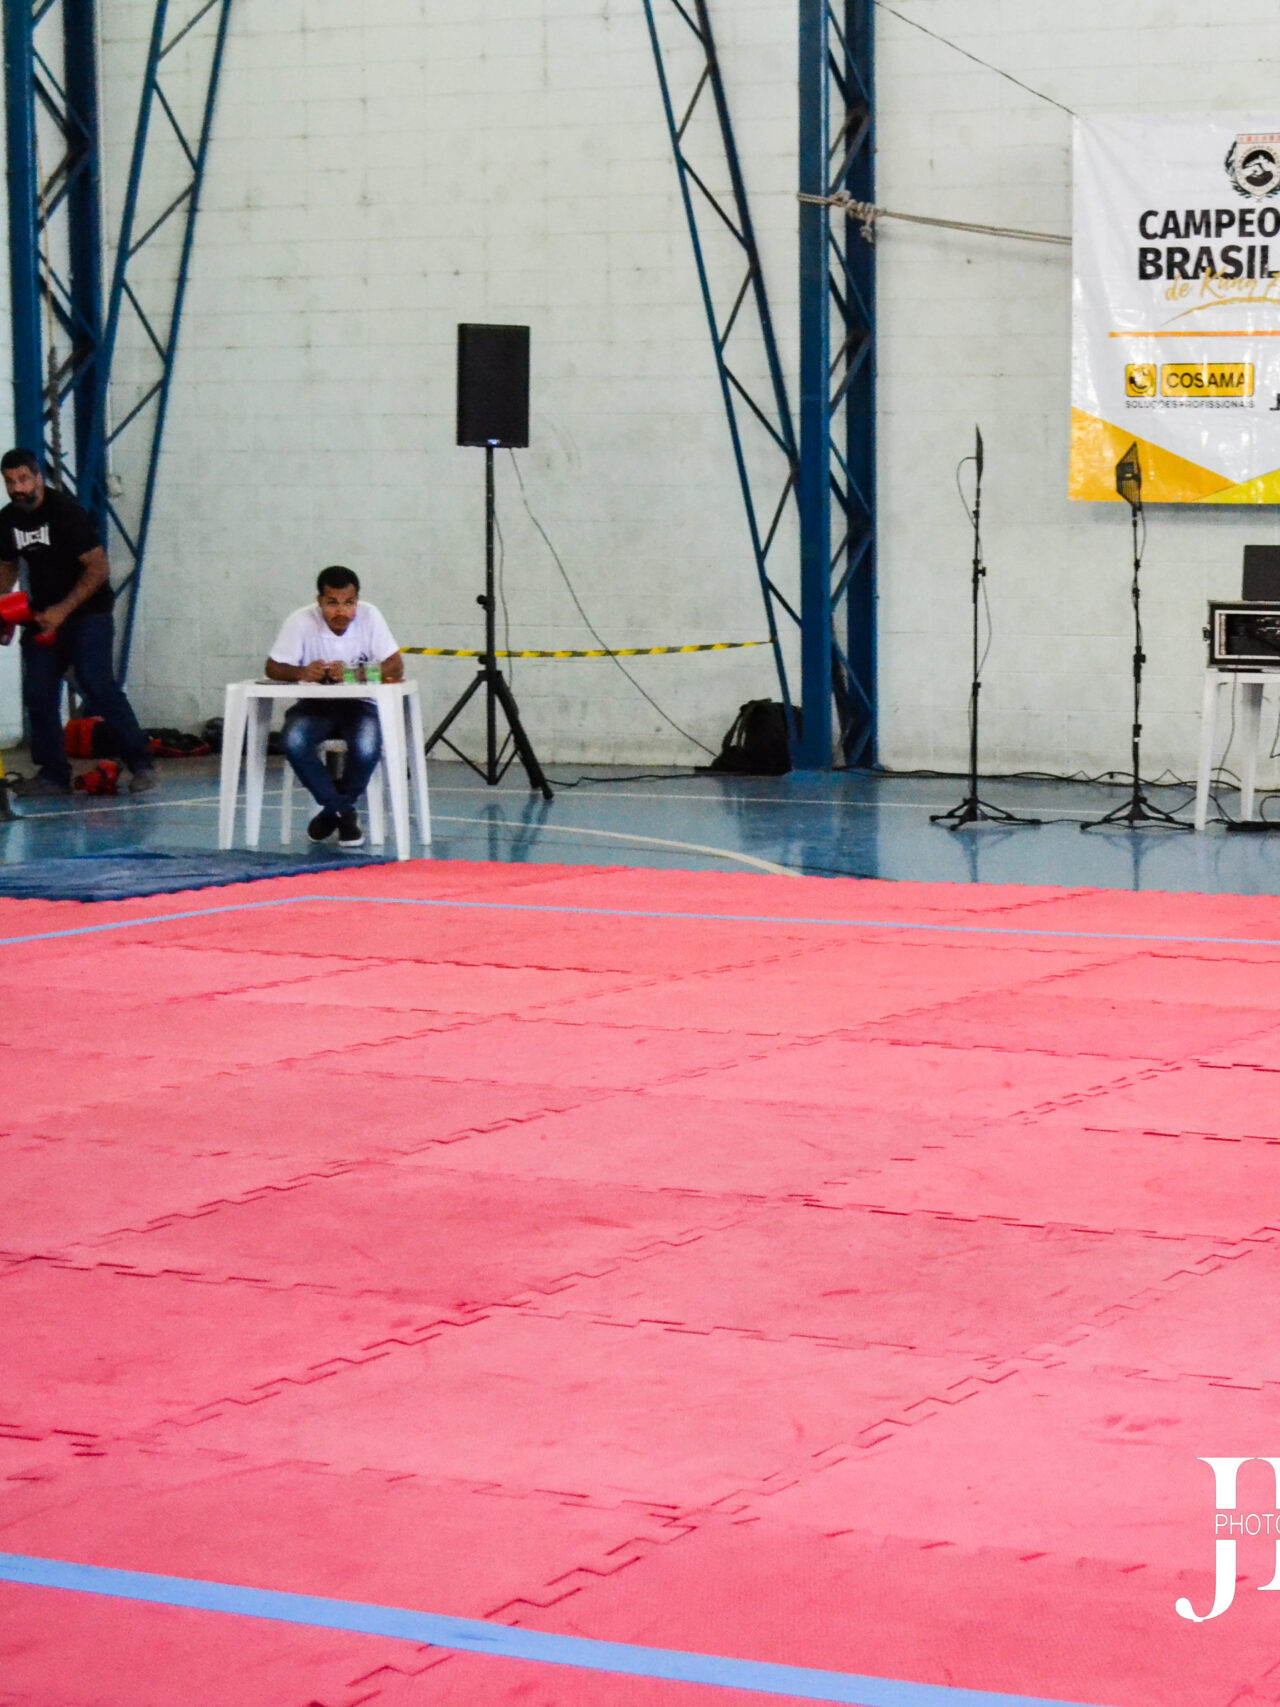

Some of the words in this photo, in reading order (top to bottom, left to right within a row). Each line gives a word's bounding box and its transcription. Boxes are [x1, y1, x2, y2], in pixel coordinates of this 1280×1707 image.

[1165, 274, 1191, 301] de
[1200, 268, 1258, 299] Kung
[1166, 372, 1246, 388] COSAMA
